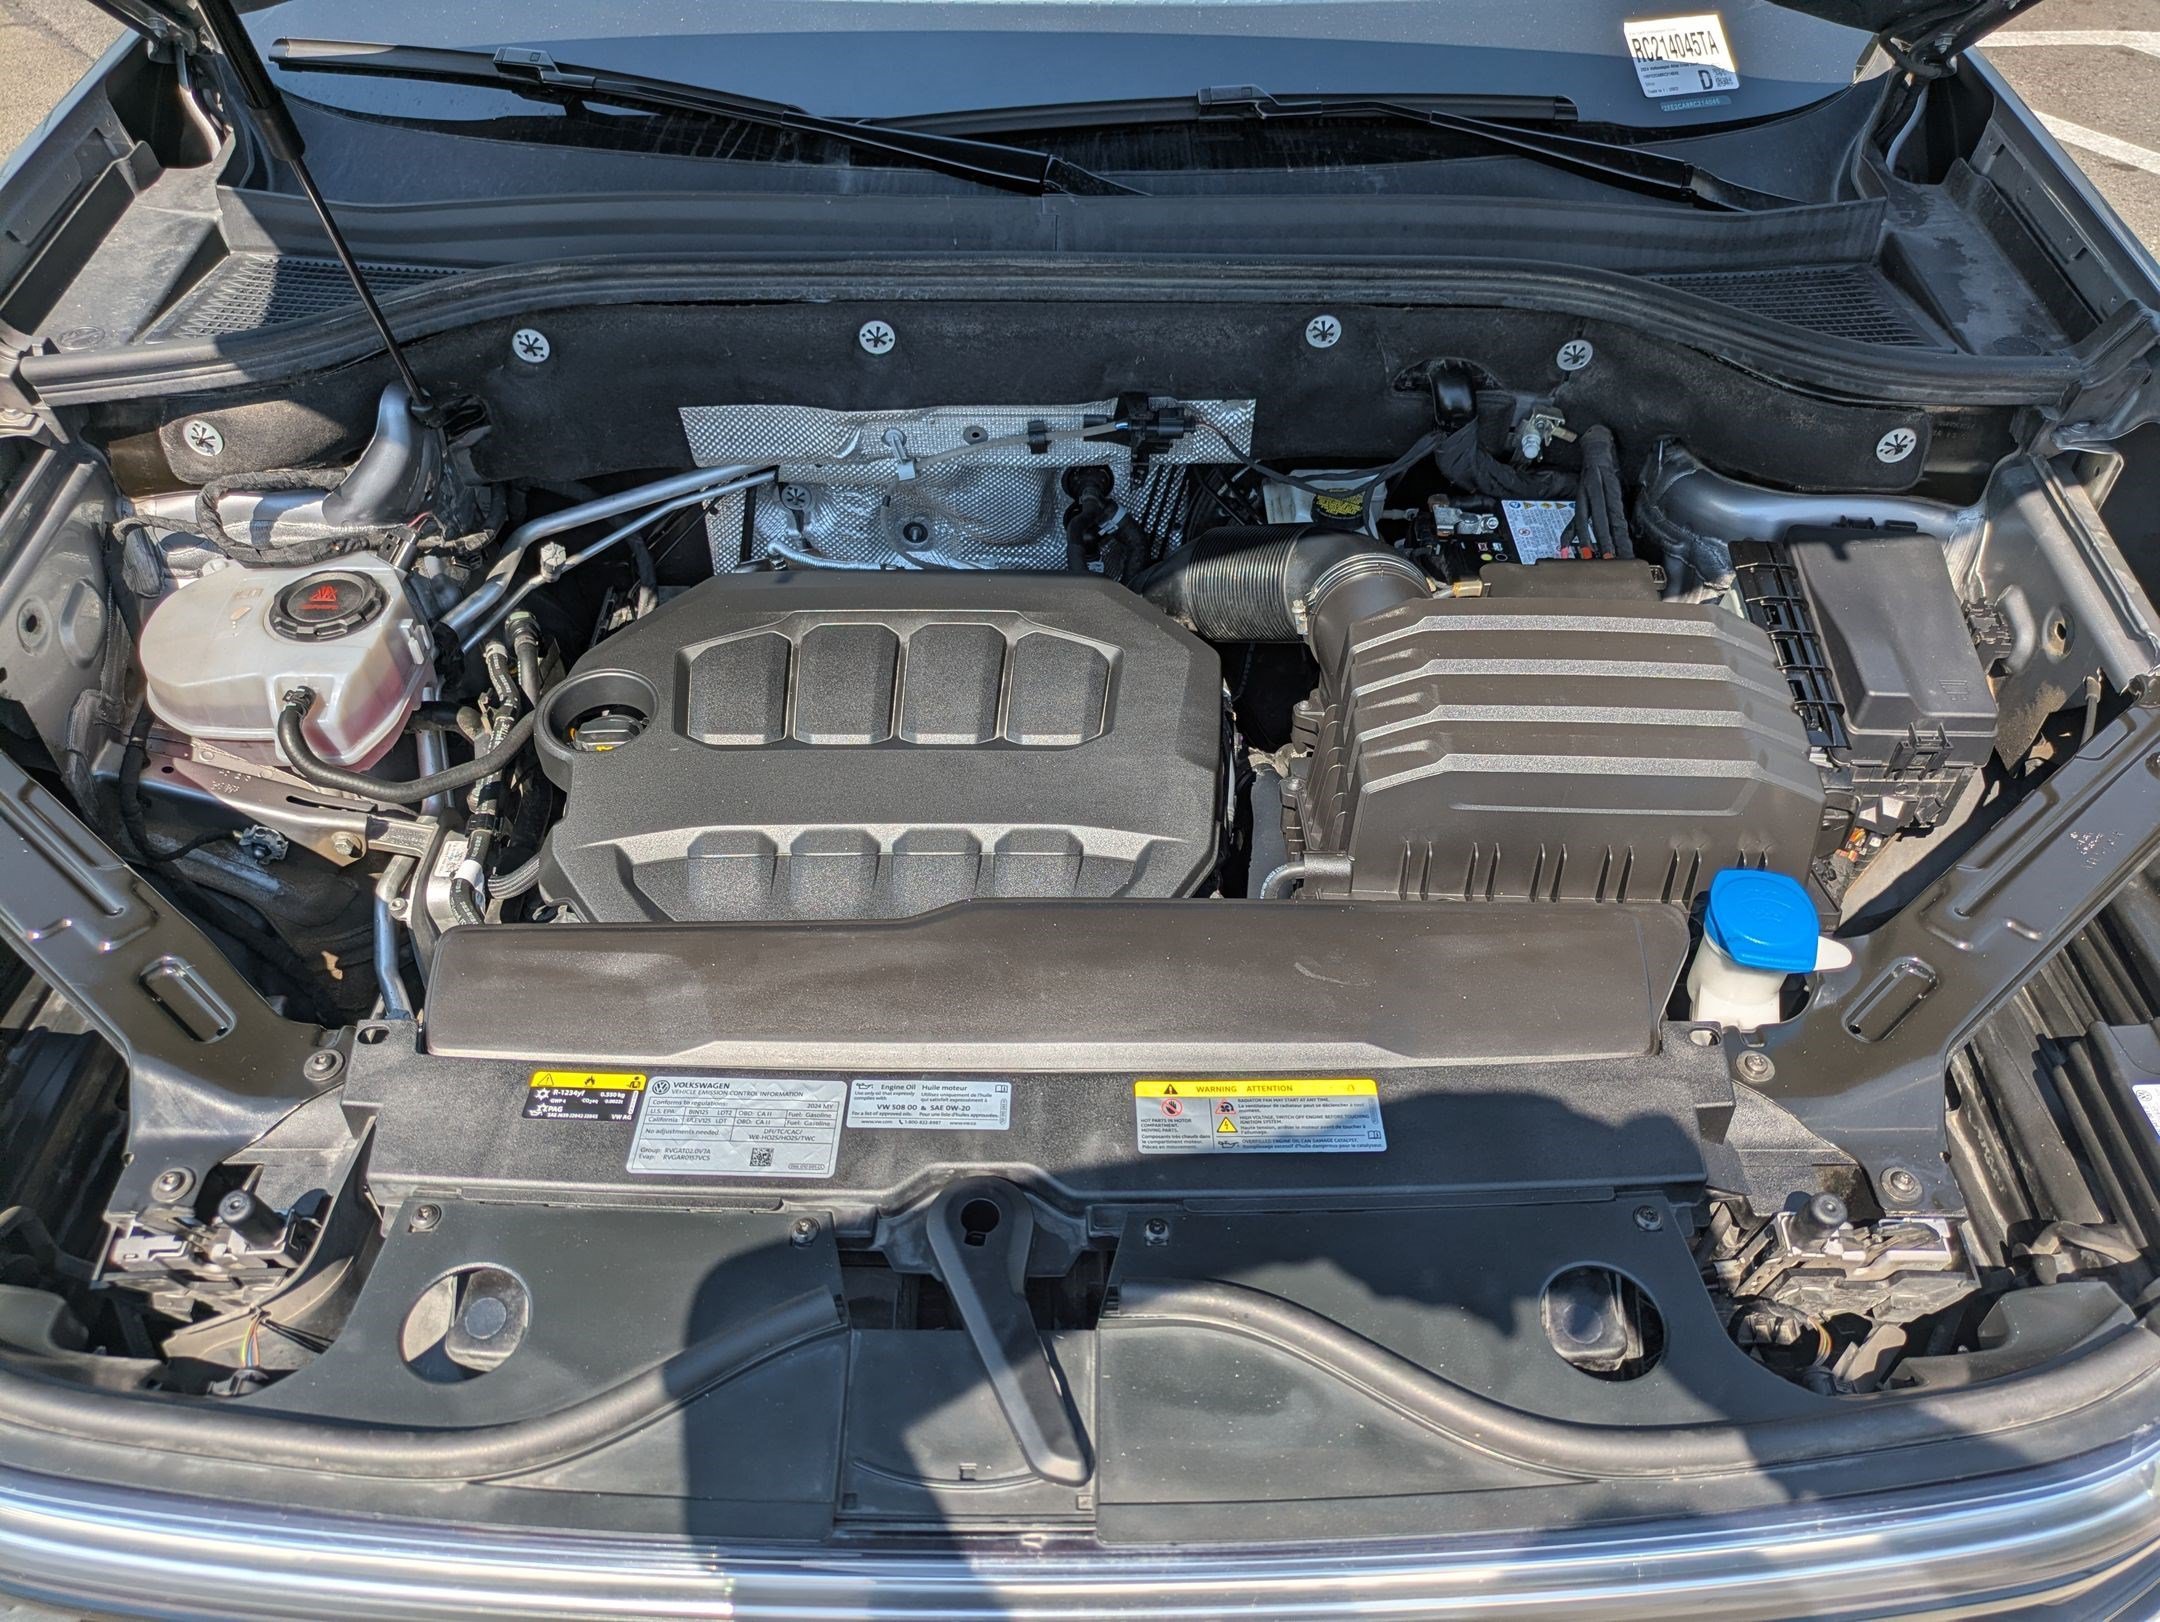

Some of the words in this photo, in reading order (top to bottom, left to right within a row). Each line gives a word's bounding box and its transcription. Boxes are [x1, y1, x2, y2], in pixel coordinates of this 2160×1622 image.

[1632, 30, 1719, 63] RC214045TA
[1698, 70, 1713, 90] D
[552, 1090, 586, 1098] R-1234yf
